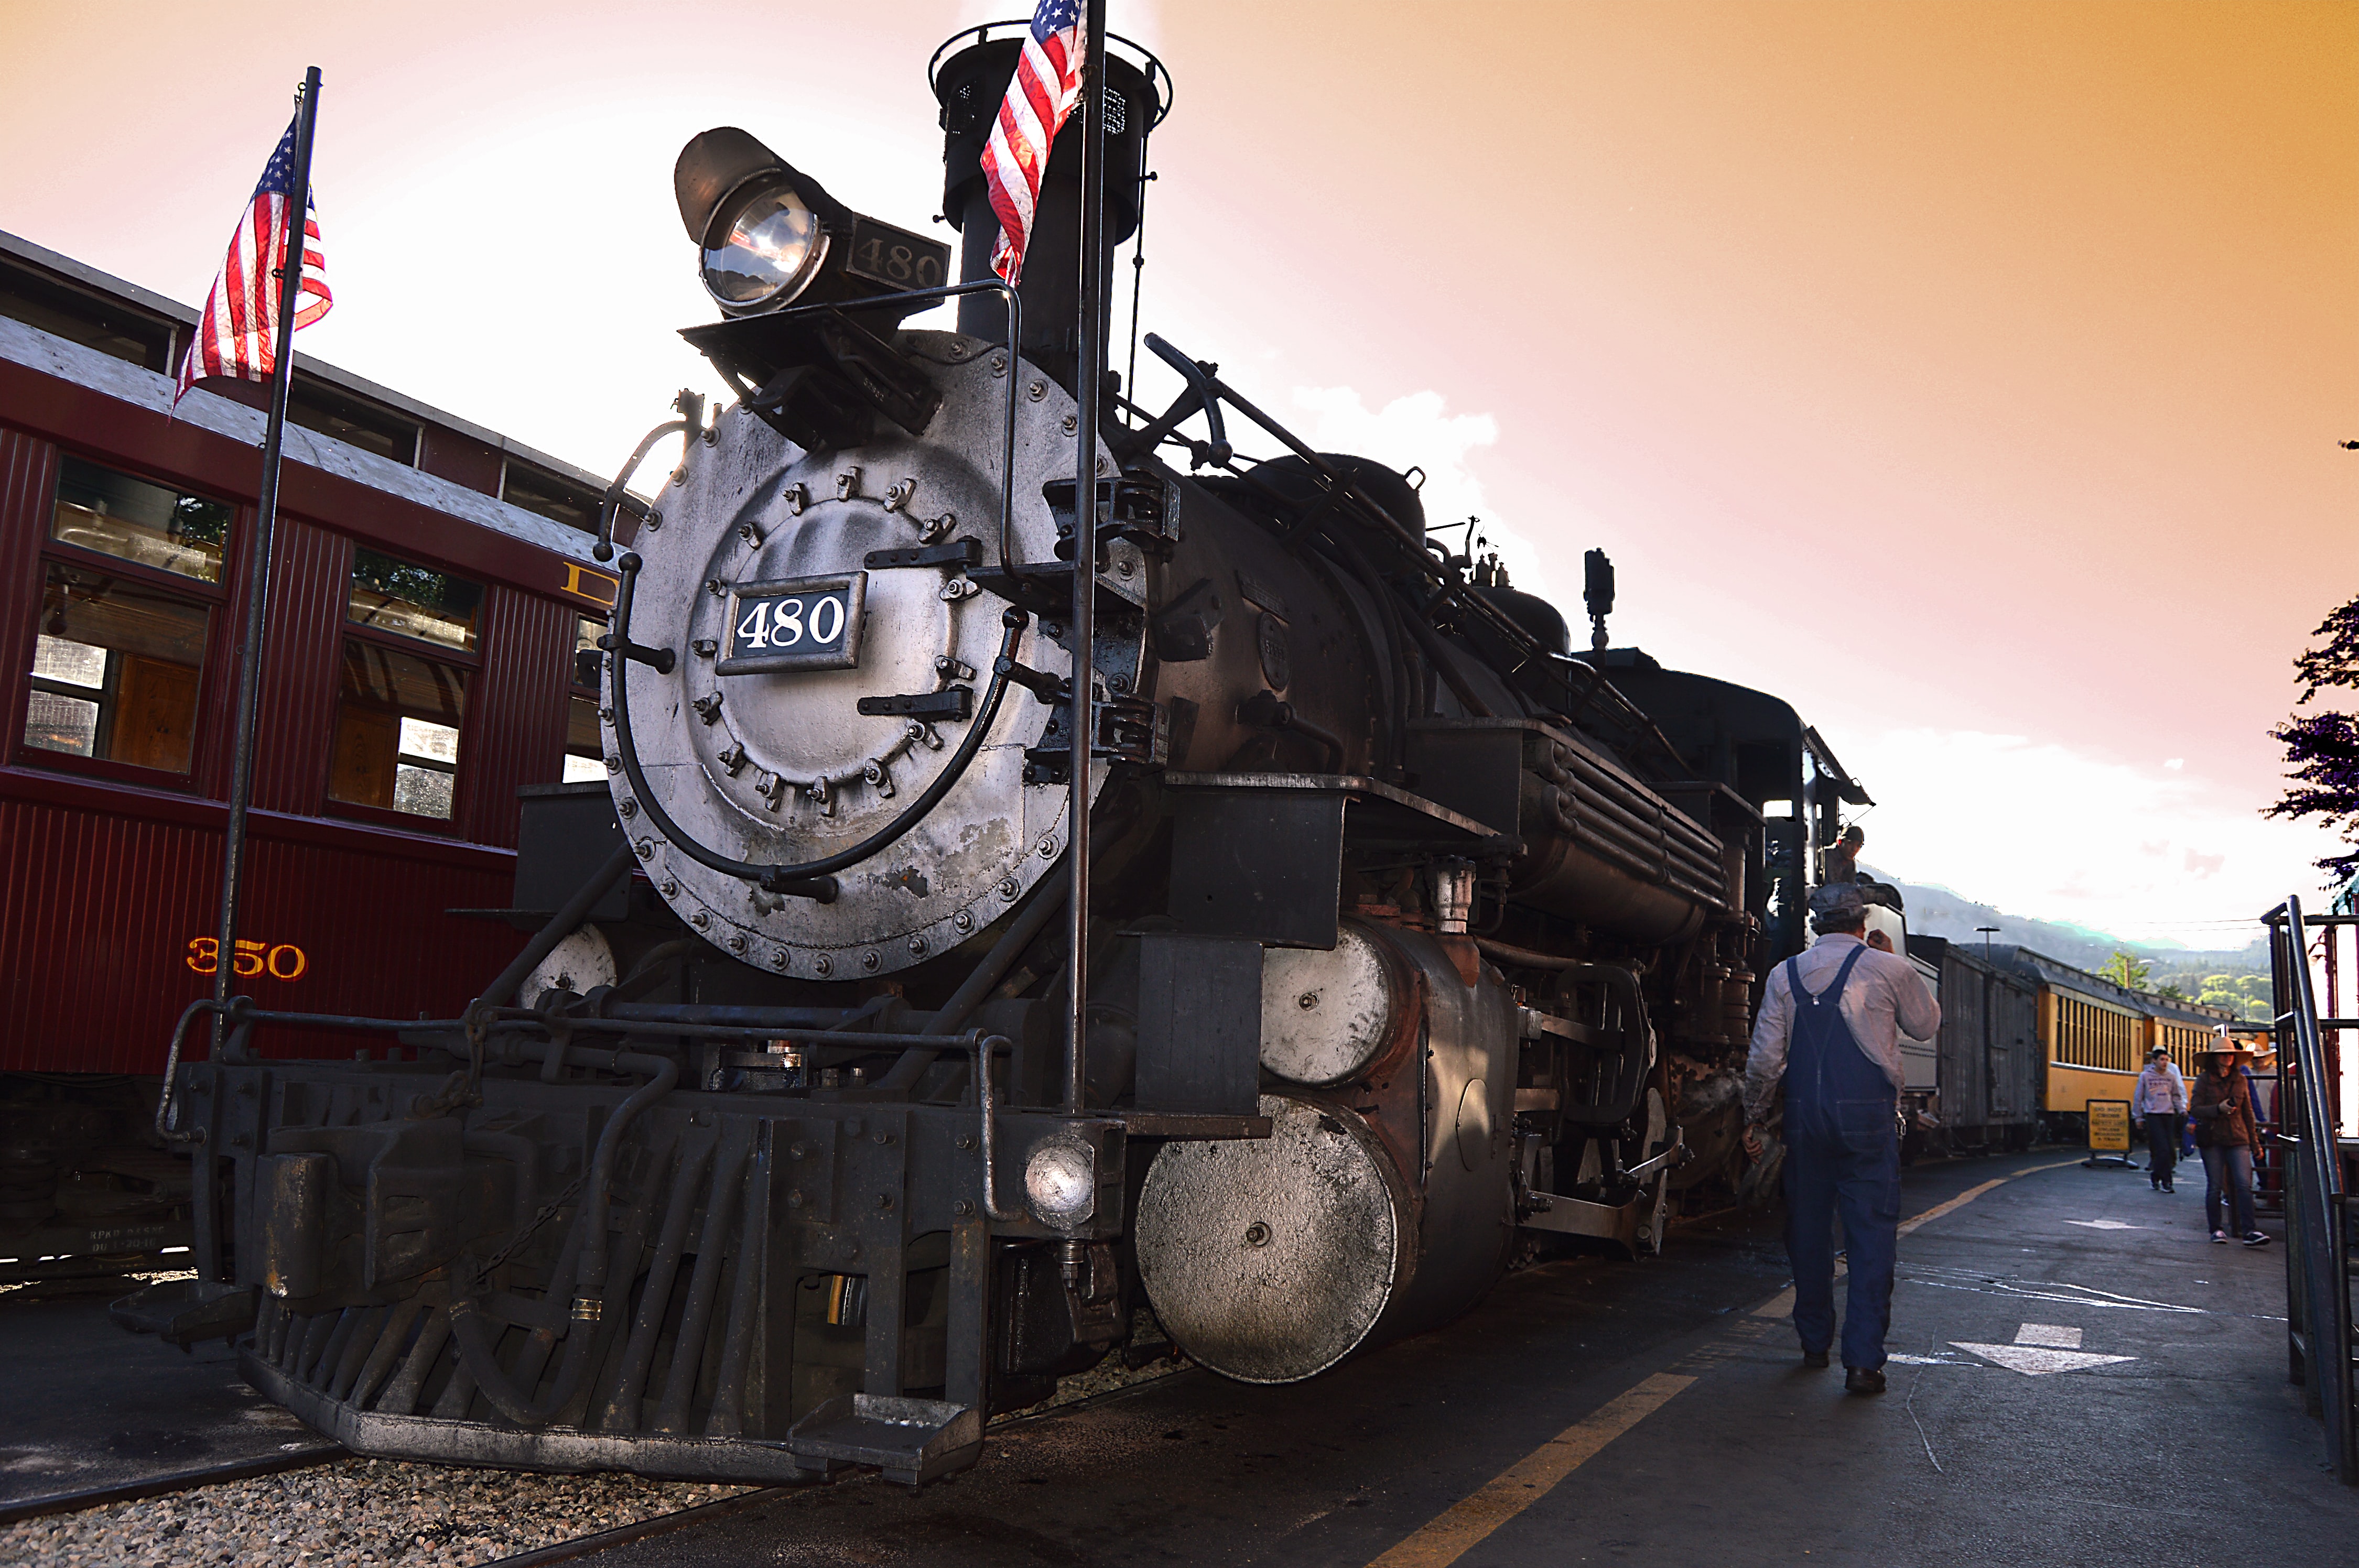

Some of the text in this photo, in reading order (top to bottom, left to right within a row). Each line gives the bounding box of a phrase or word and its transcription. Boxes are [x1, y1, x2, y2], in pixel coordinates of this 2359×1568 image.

[856, 238, 942, 288] 480
[737, 596, 845, 648] 480
[187, 937, 306, 979] 350
[90, 1229, 120, 1239] RPKD
[93, 1243, 107, 1251] DU
